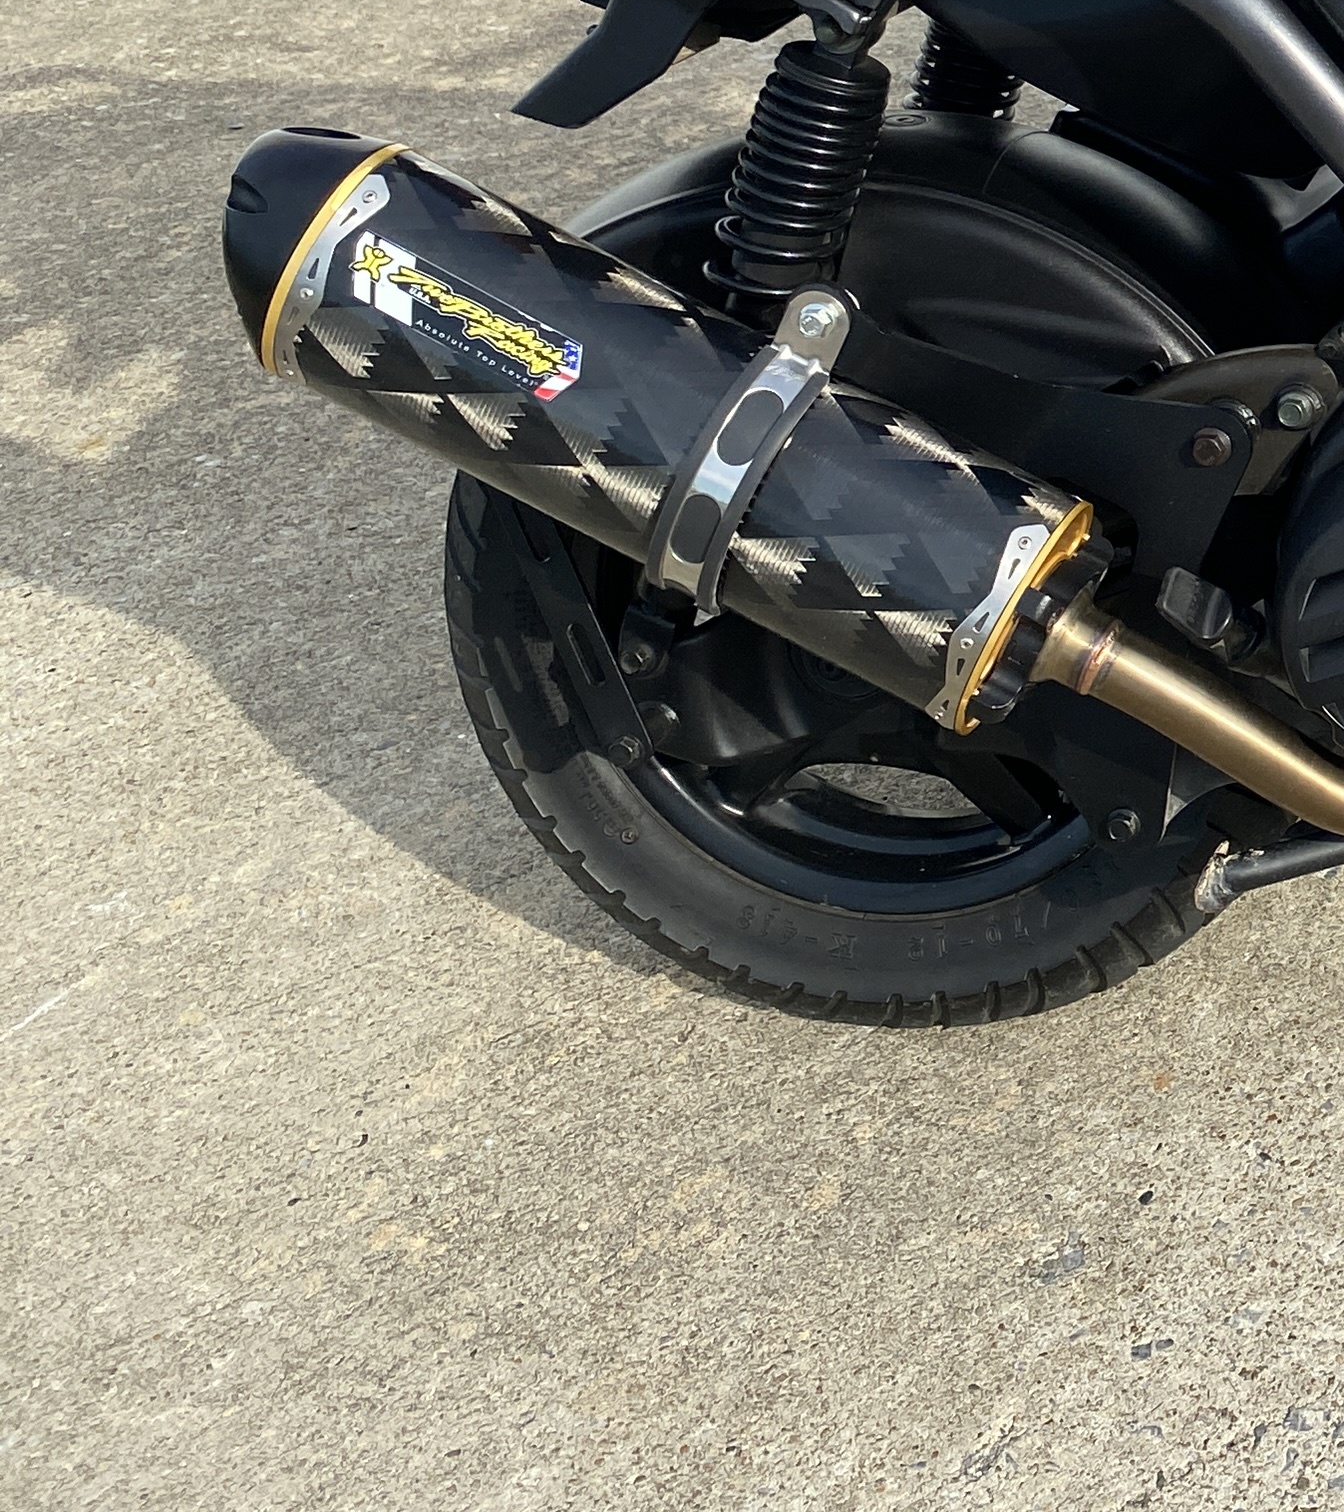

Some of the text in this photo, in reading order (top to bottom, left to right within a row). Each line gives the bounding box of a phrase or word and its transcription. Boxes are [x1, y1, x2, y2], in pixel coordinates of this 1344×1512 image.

[415, 319, 536, 387] Absolute Top Level
